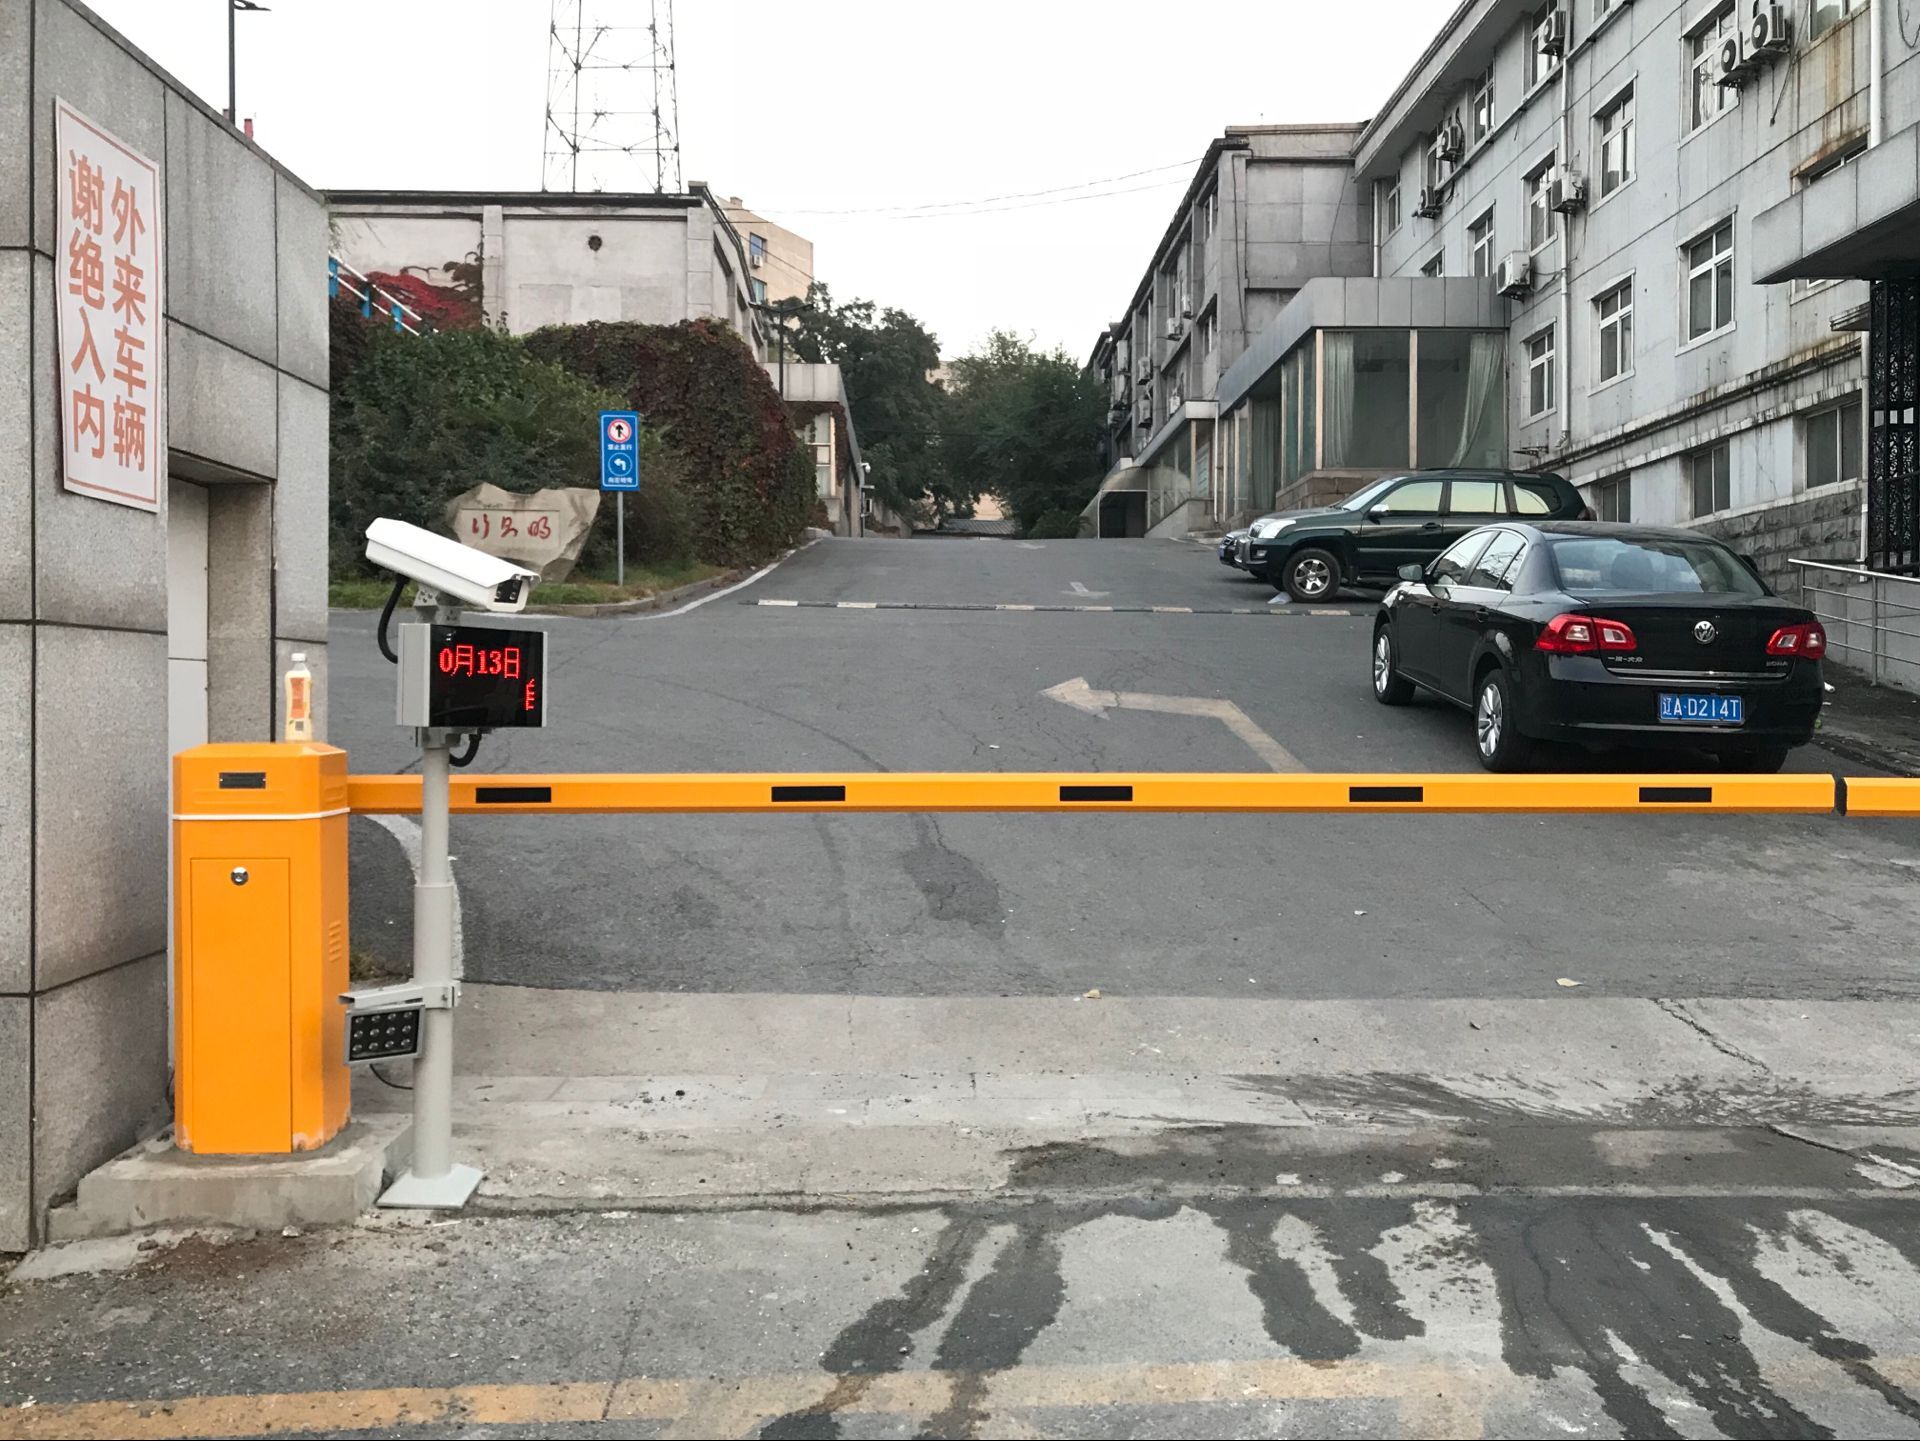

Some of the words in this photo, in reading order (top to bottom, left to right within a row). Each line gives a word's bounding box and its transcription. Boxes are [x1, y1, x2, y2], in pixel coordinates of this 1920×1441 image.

[68, 148, 106, 459] 谢绝入内
[110, 177, 146, 472] 外来车辆
